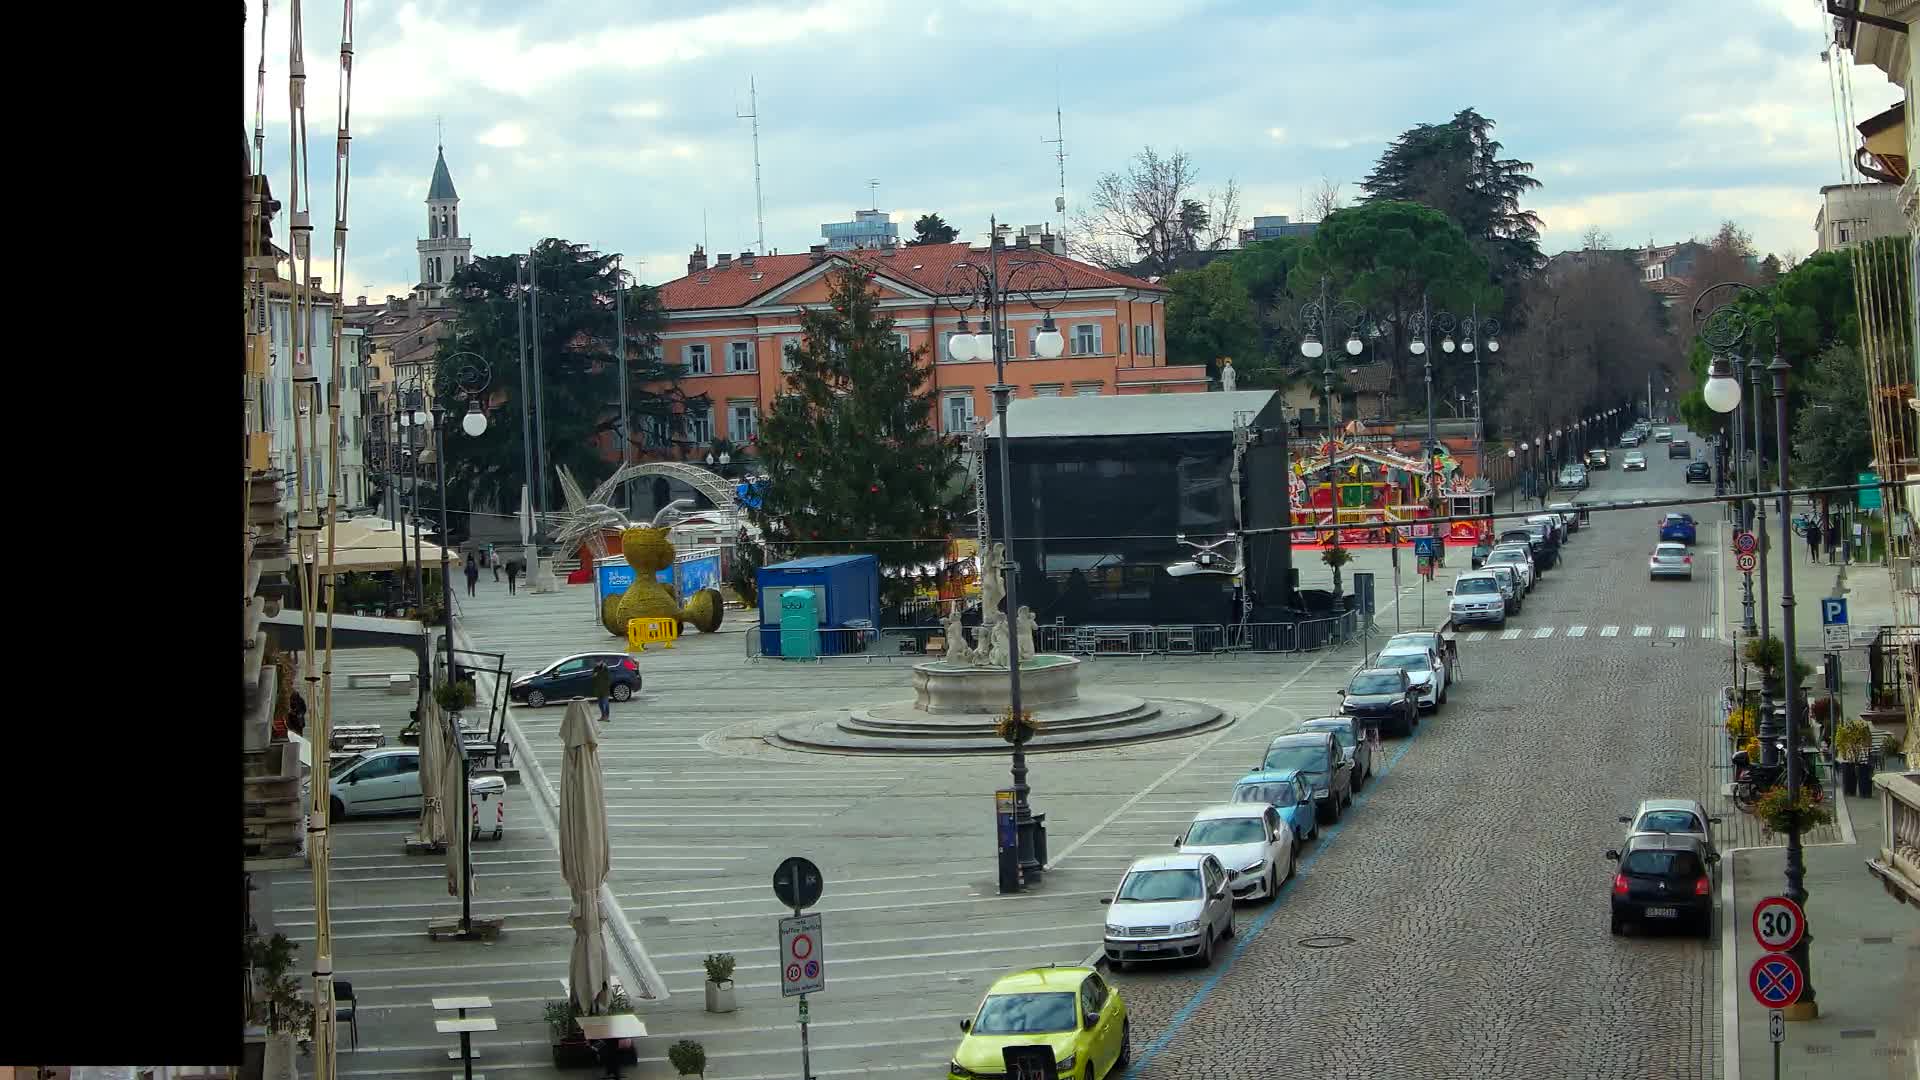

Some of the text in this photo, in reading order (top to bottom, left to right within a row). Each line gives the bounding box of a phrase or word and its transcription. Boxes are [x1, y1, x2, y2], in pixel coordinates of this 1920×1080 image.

[1742, 558, 1753, 566] 20
[1826, 602, 1842, 622] P
[1762, 911, 1792, 937] 30
